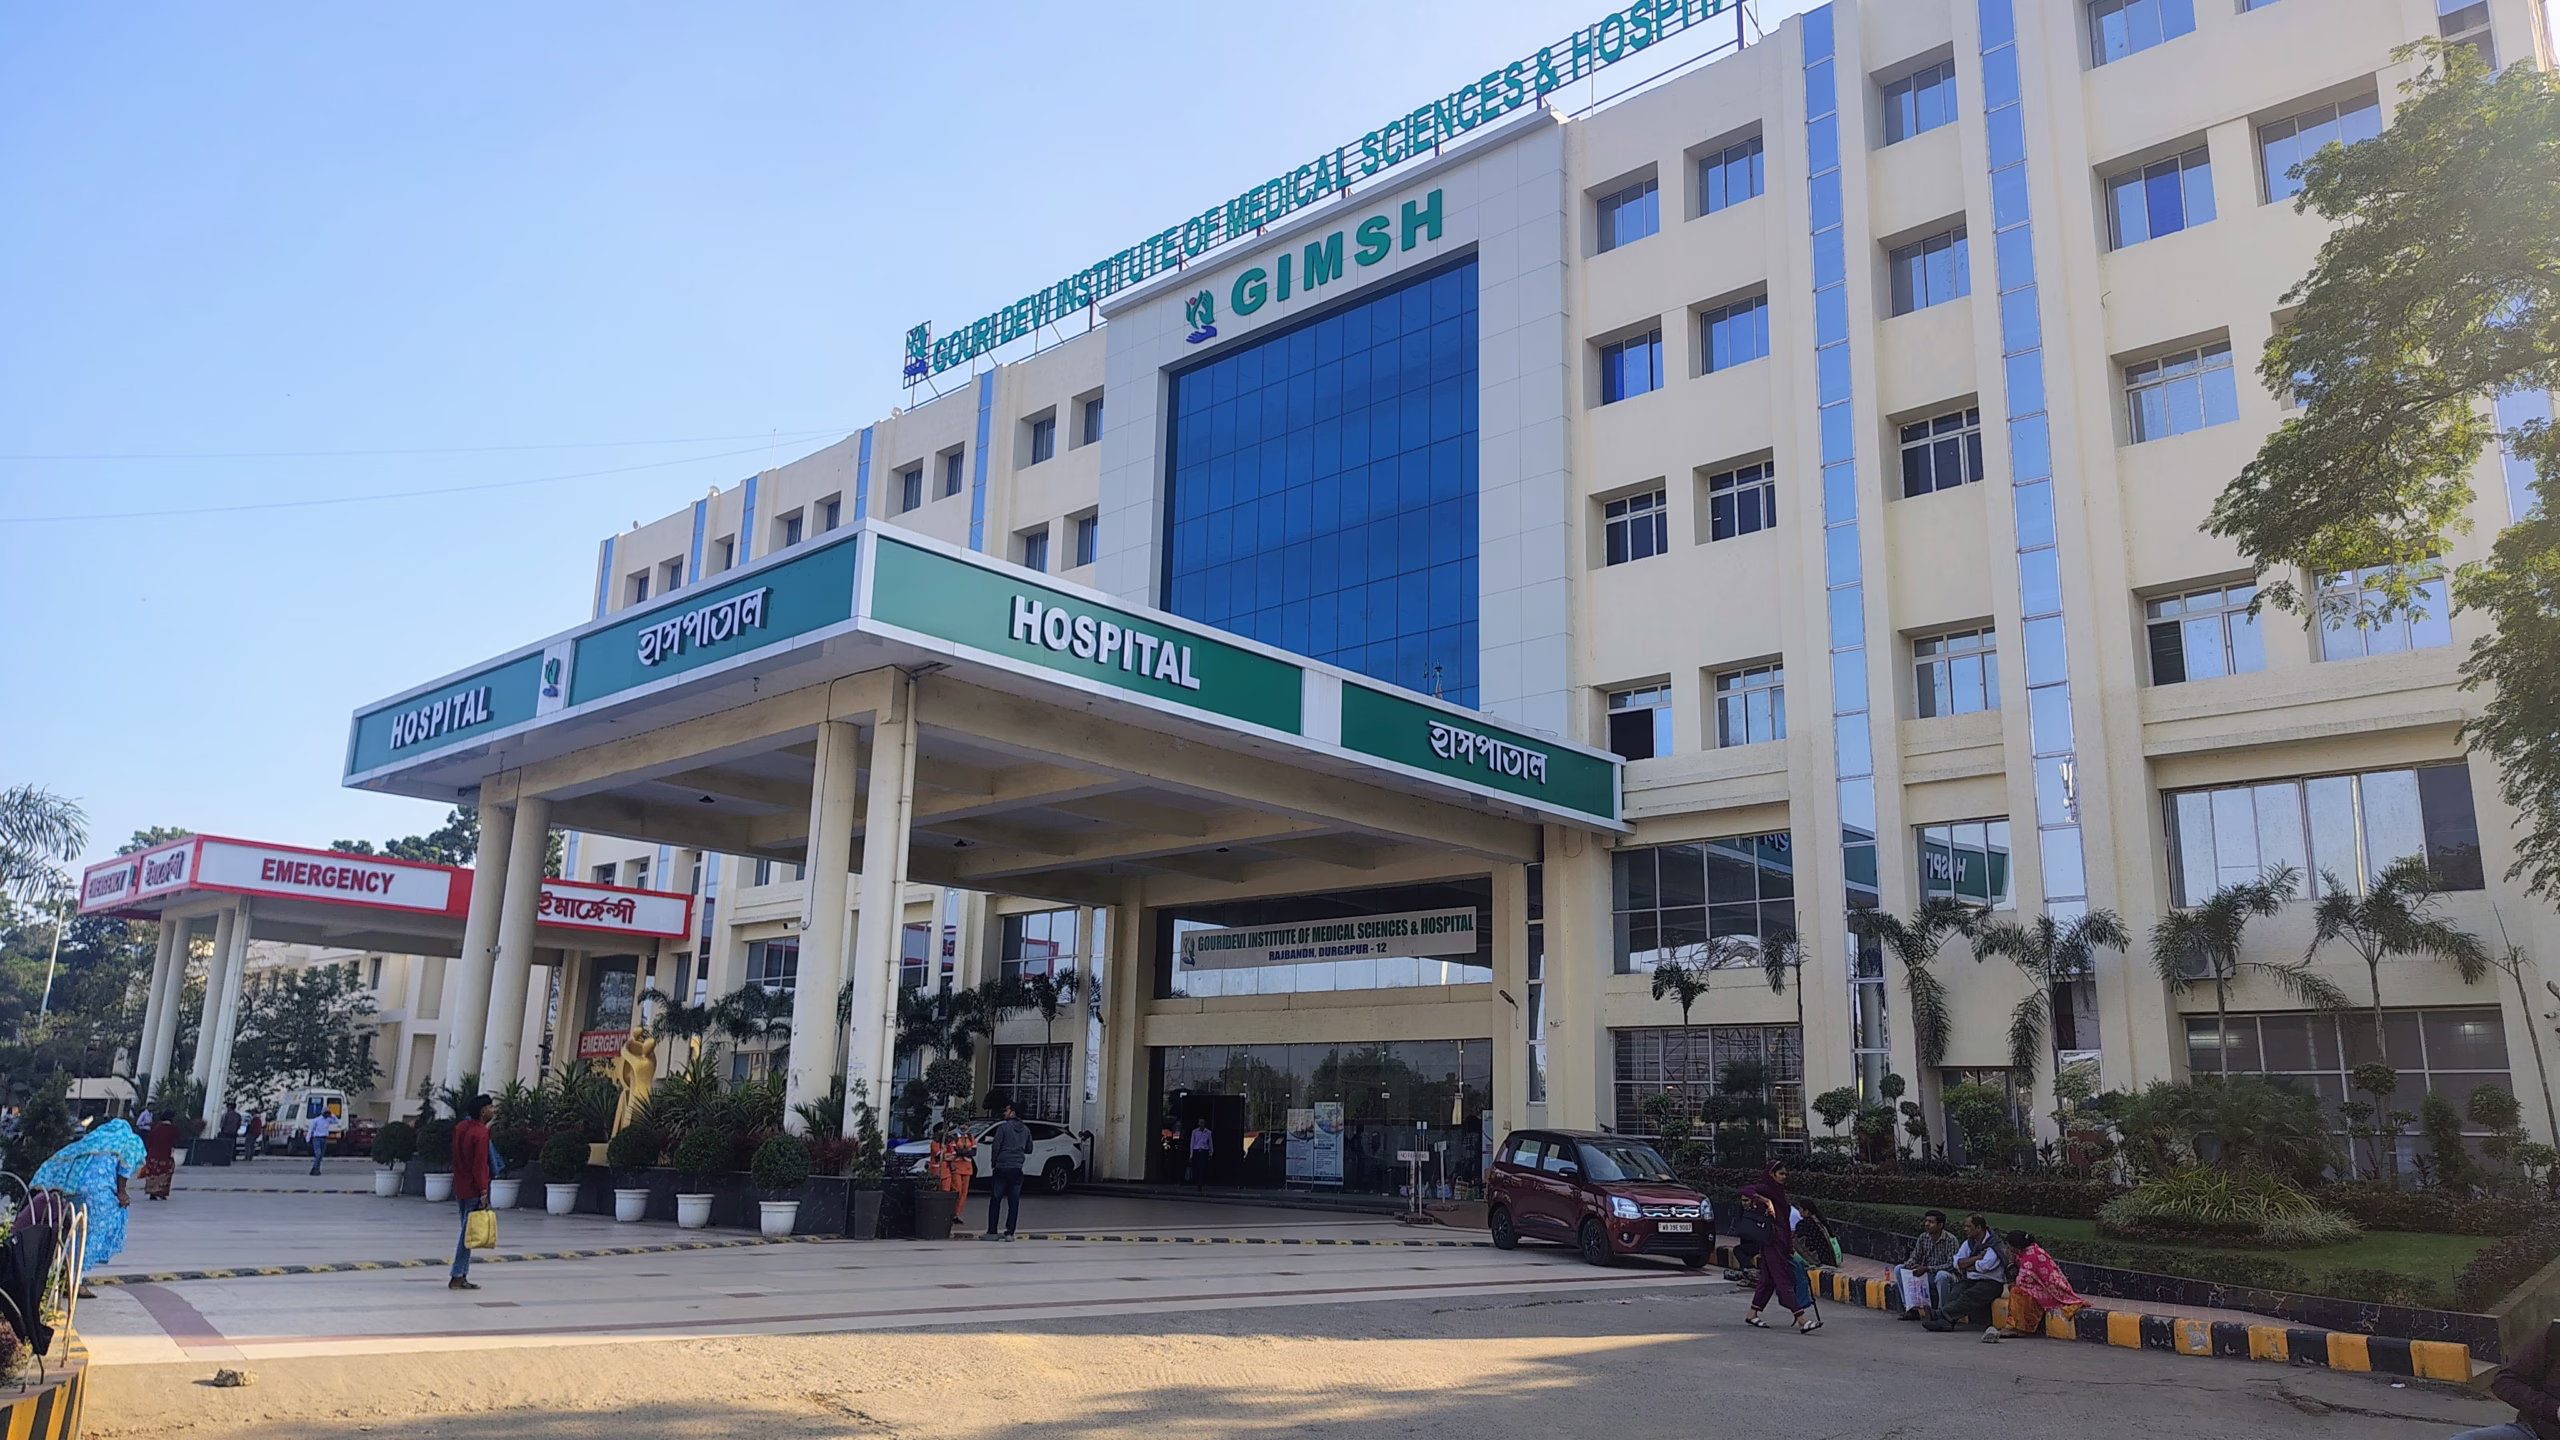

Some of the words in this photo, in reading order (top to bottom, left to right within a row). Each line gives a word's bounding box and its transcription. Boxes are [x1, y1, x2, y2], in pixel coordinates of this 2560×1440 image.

[933, 313, 997, 373] GOURI
[1000, 287, 1051, 343] DEVI
[1056, 226, 1178, 319] INSTITUTE
[1183, 206, 1219, 257] OF
[1226, 147, 1350, 240] MEDICAL
[1361, 61, 1525, 176] SCIENCES
[1535, 47, 1561, 94] &
[1572, 0, 1726, 80] HOSPI
[1231, 188, 1443, 316] GIMSH
[638, 586, 768, 666] হাসপাতাল
[1010, 594, 1201, 690] HOSPITAL
[389, 685, 489, 751] HOSPITAL
[1428, 719, 1549, 785] হাসপাতাল
[88, 869, 128, 899] EMERGENCY
[260, 857, 396, 895] EMERGENCY
[1248, 928, 1297, 948] INSTITUTE
[1298, 926, 1310, 944] OF
[1312, 922, 1355, 943] MEDICAL
[1357, 918, 1408, 940] SCIENCES
[1410, 920, 1418, 936] &
[1420, 913, 1474, 935] HOSPITAL
[1269, 947, 1317, 961] RAJBANDH,
[1318, 943, 1369, 957] DURGAPUR
[1376, 942, 1387, 953] 12
